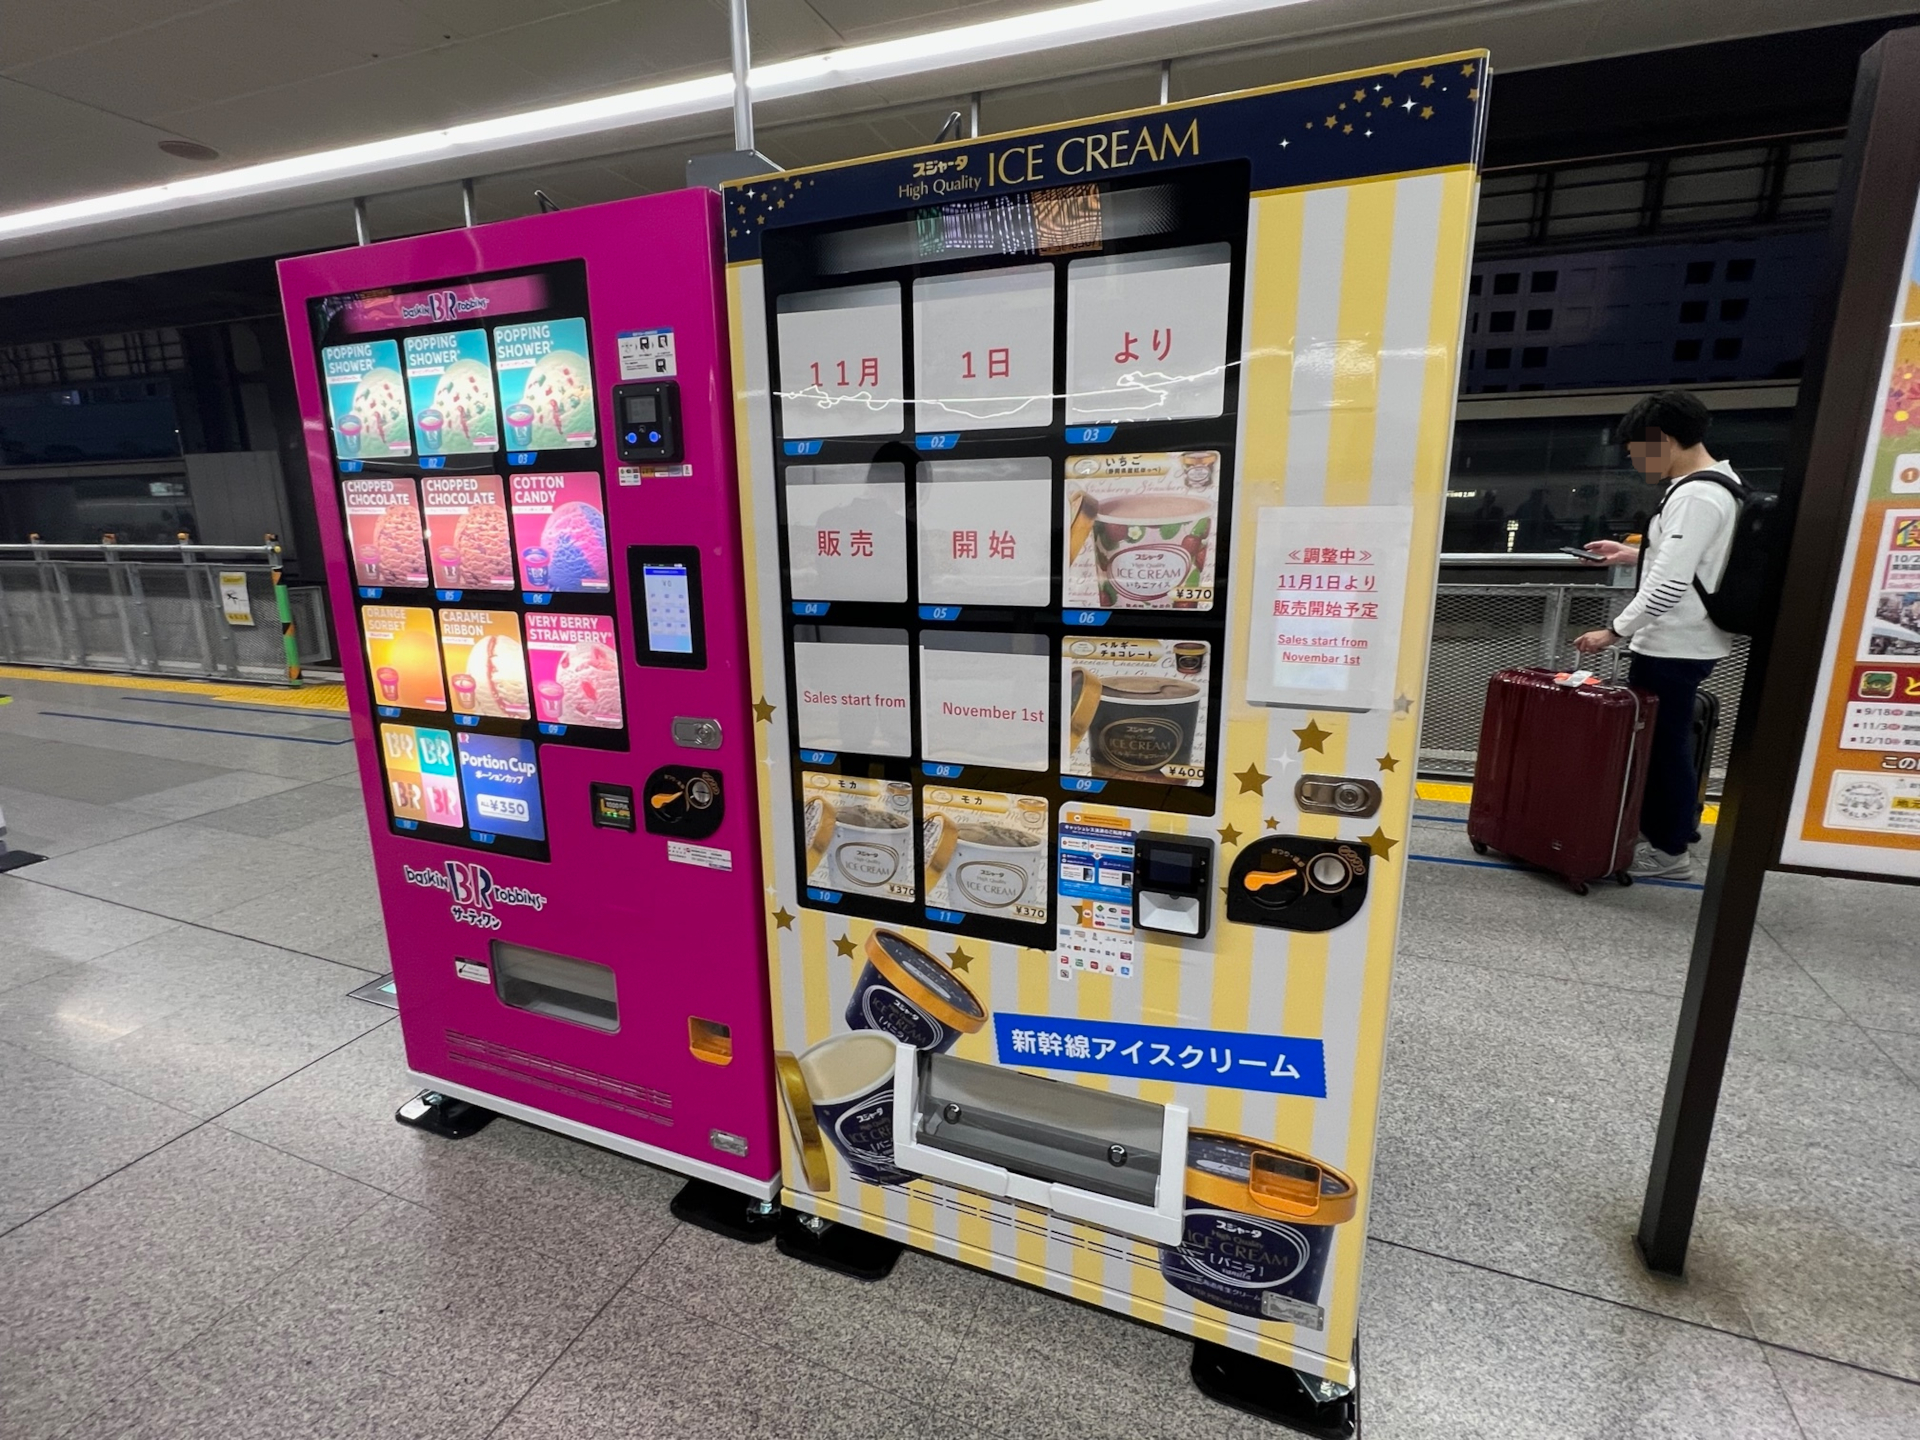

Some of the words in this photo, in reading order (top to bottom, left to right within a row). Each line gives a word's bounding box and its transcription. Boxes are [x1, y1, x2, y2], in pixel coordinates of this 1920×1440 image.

[988, 144, 1044, 187] ICE
[1056, 117, 1199, 175] CREAM
[913, 154, 968, 177] スジャータ
[899, 180, 930, 199] High
[933, 174, 983, 197] Quality
[496, 325, 550, 343] POPPING
[407, 335, 457, 352] POPPING
[1114, 328, 1173, 364] より
[326, 345, 372, 360] POPPING
[961, 348, 1011, 379] 1日
[810, 357, 880, 388] 11月
[930, 434, 945, 448] 02
[1083, 429, 1100, 442] 03
[797, 441, 810, 454] 01
[428, 458, 438, 468] 02
[517, 453, 528, 464] 03
[1105, 455, 1141, 467] いちご
[1906, 471, 1914, 480] 1
[347, 480, 394, 492] CHOPPED
[427, 479, 478, 492] CHOPPED
[513, 476, 565, 489] COTTON
[349, 493, 410, 506] CHOCOLATE
[428, 493, 495, 506] CHOCOLATE
[515, 491, 557, 504] CANDY
[817, 530, 874, 558] 販売
[952, 530, 1016, 560] 開始
[1117, 569, 1133, 578] ICE
[1137, 568, 1181, 579] CREAM
[1278, 575, 1375, 590] 11月1日より
[532, 594, 543, 604] 06
[1176, 589, 1211, 599] ¥370
[367, 608, 406, 620] ORANGE
[805, 603, 818, 614] 04
[933, 607, 947, 619] 05
[1274, 600, 1378, 618] 販売開始予定
[442, 612, 493, 624] CARAMEL
[528, 615, 556, 627] VERY
[559, 617, 598, 629] BERRY
[1079, 612, 1095, 624] 06
[369, 620, 406, 631] SORBET
[444, 624, 483, 635] RIBBON
[1101, 641, 1138, 649] ベルギー
[1278, 635, 1308, 645] Sales
[1312, 635, 1337, 646] start
[1341, 637, 1368, 647] from
[1101, 650, 1153, 659] チョコレート
[1343, 654, 1360, 664] 1st
[803, 690, 837, 705] Sales
[841, 693, 871, 706] start
[875, 694, 906, 708] from
[942, 702, 1017, 721] November
[1021, 708, 1045, 723] 1st
[1865, 708, 1890, 716] 9/18
[1863, 722, 1888, 731] 11/3
[1109, 738, 1126, 749] ICE
[1129, 740, 1170, 750] CREAM
[1860, 736, 1891, 745] 12/10
[812, 752, 824, 762] 07
[460, 751, 508, 771] Portion
[509, 757, 536, 777] Cup
[936, 766, 949, 776] 08
[1169, 766, 1205, 778] ¥400
[837, 779, 857, 789] モカ
[1076, 779, 1092, 790] 09
[961, 795, 983, 806] モカ
[490, 800, 525, 815] ¥350
[845, 861, 858, 872] ICE
[860, 863, 890, 876] CREAM
[403, 865, 450, 891] baskin
[444, 861, 493, 909] BR
[493, 885, 543, 911] robbins
[889, 884, 915, 896] ¥370
[967, 881, 981, 891] ICE
[983, 883, 1016, 896] CREAM
[819, 891, 830, 901] 10
[451, 905, 502, 930] サーティワン
[939, 911, 951, 921] 11
[1016, 906, 1045, 918] ¥370
[1012, 1029, 1301, 1079] 新幹線アイスクリーム
[1216, 1220, 1262, 1238] スジャータ
[1212, 1230, 1231, 1241] High
[1233, 1236, 1264, 1249] Quality
[1187, 1229, 1214, 1249] ICE
[1220, 1242, 1288, 1267] CREAM
